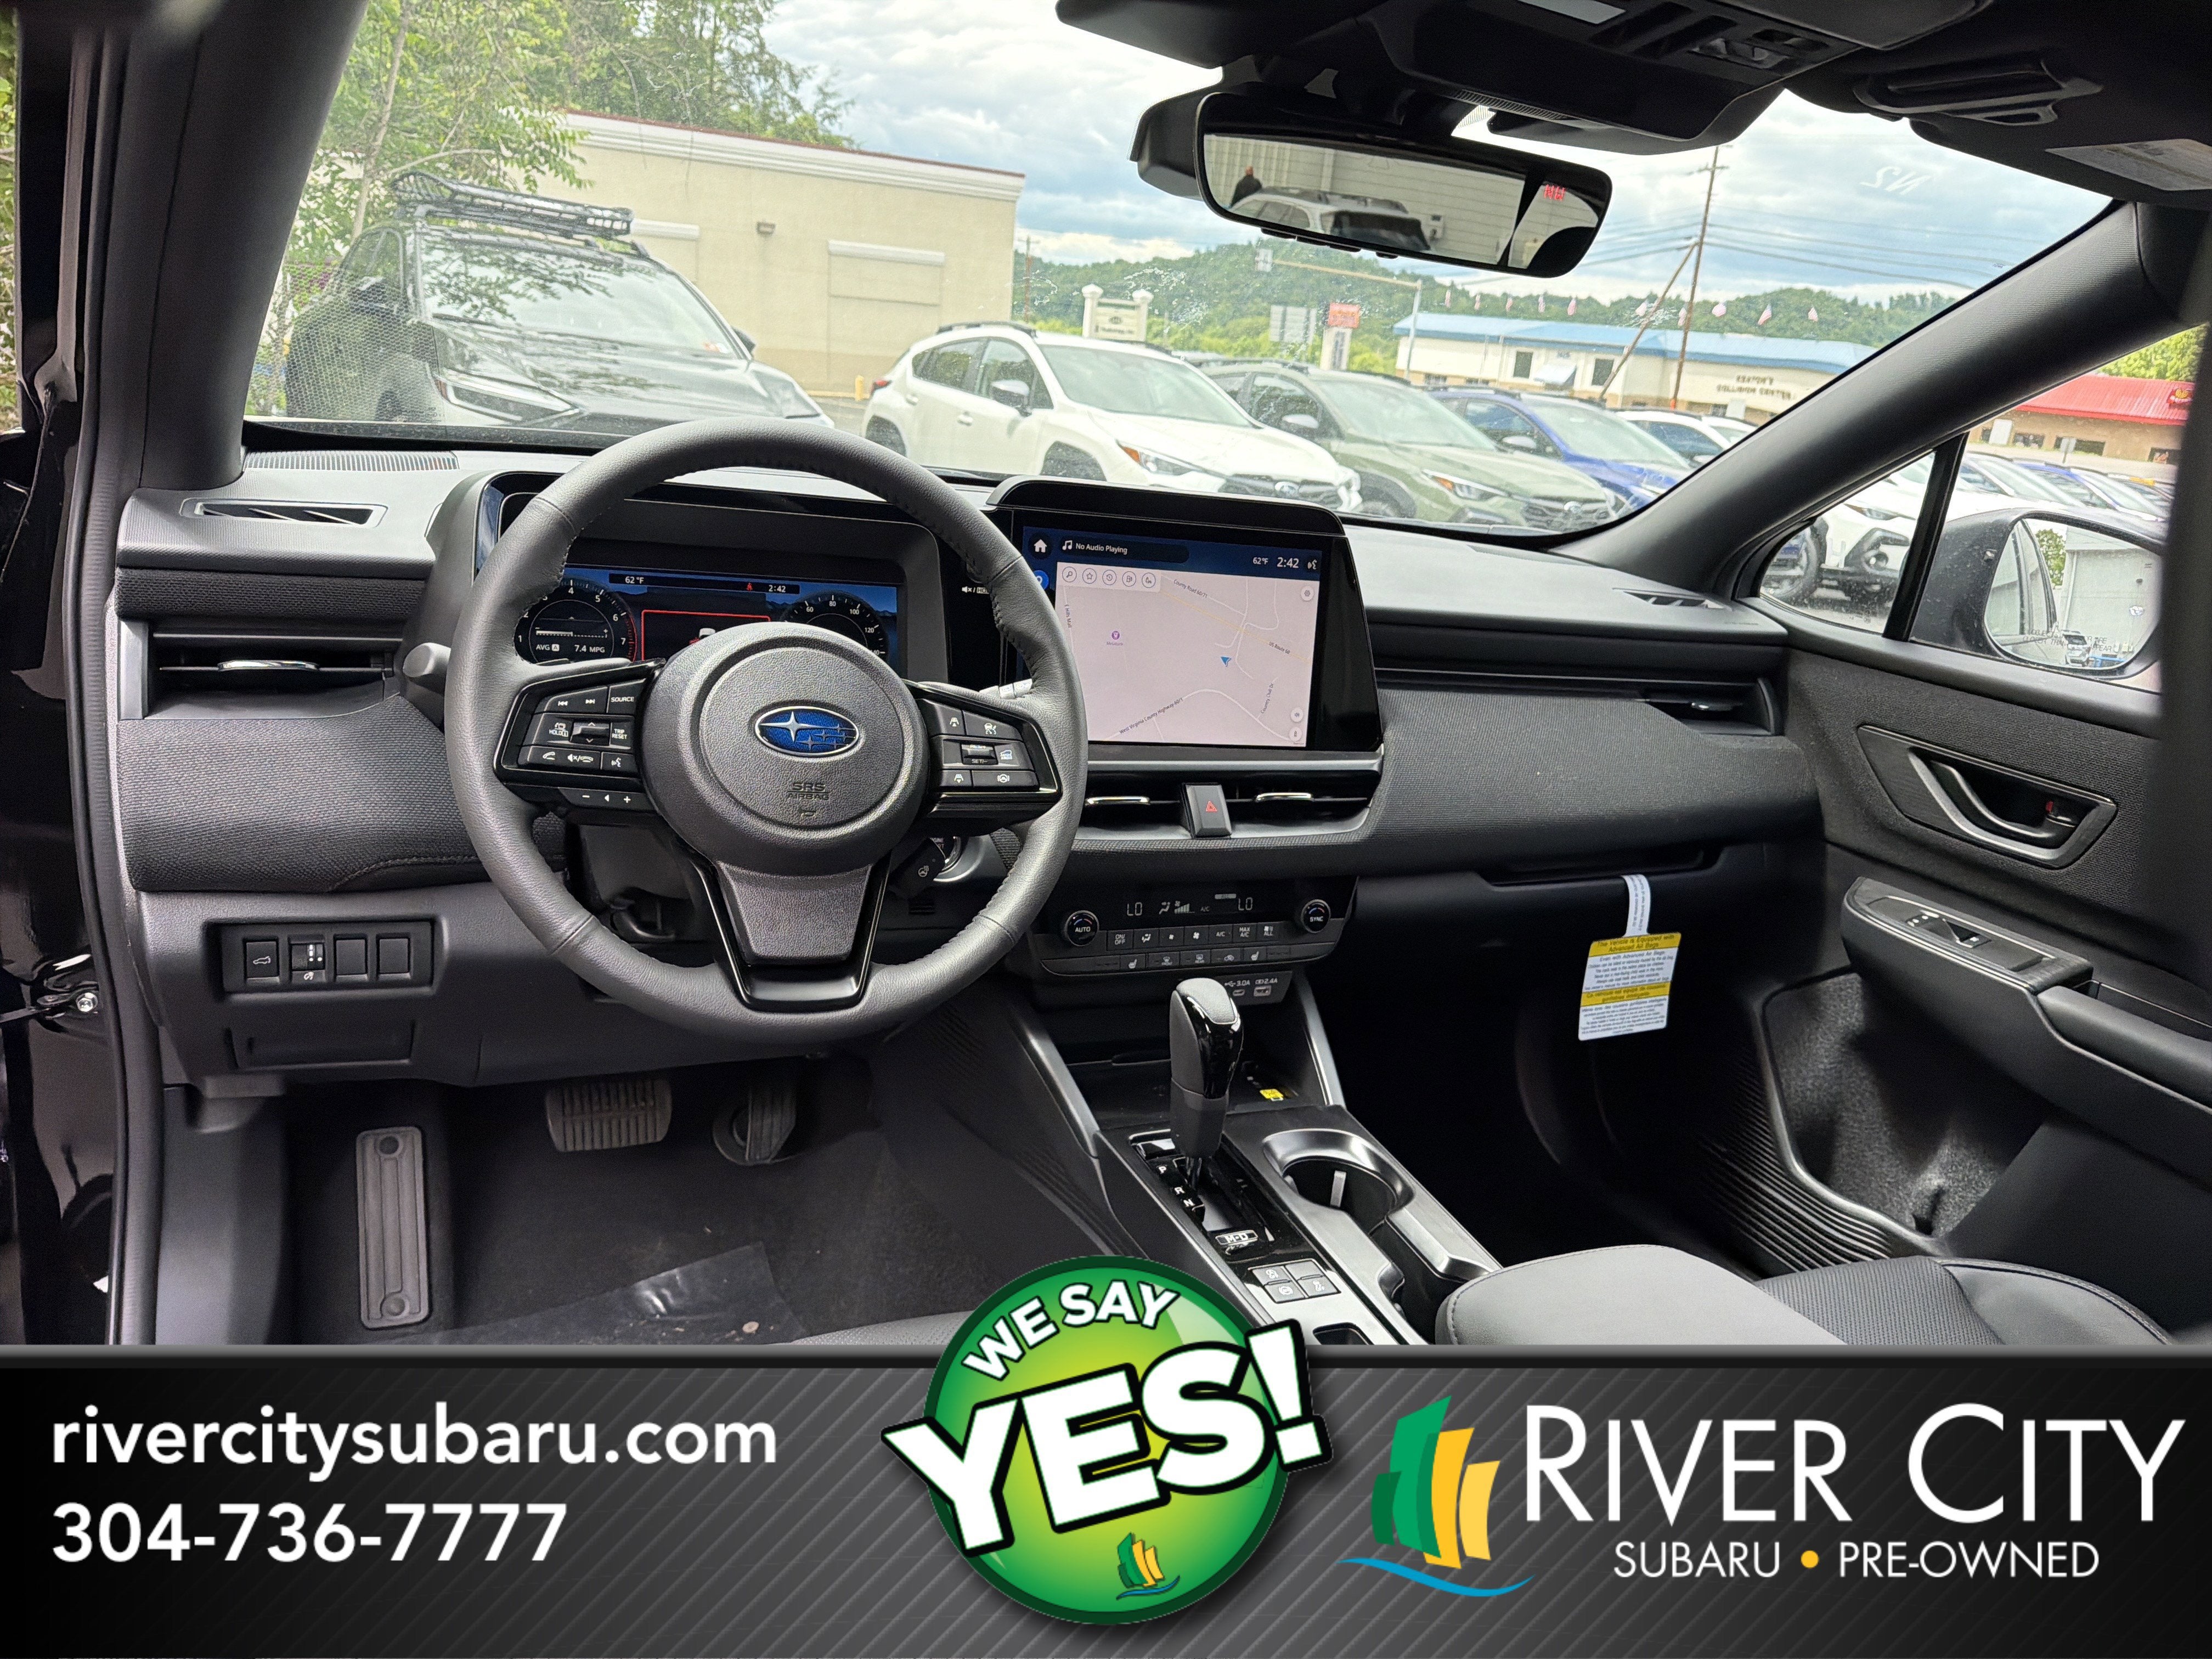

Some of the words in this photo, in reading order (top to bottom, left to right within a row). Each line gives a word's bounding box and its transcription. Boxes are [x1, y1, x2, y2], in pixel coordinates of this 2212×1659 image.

[1105, 545, 1128, 555] Playing
[1252, 557, 1269, 565] 62°F
[1277, 557, 1300, 568] 2:42
[625, 576, 635, 584] 62
[568, 586, 574, 595] 4
[768, 584, 786, 592] 2:42
[574, 644, 587, 652] 7.4
[1274, 644, 1285, 652] Route
[1128, 719, 1144, 729] Virginia
[1144, 712, 1158, 721] County
[1157, 704, 1174, 714] Highway
[792, 782, 825, 791] SRS
[1238, 897, 1253, 911] LO
[1126, 902, 1143, 916] LO
[1158, 1166, 1167, 1174] P
[1174, 1187, 1186, 1195] R
[1183, 1199, 1195, 1207] N
